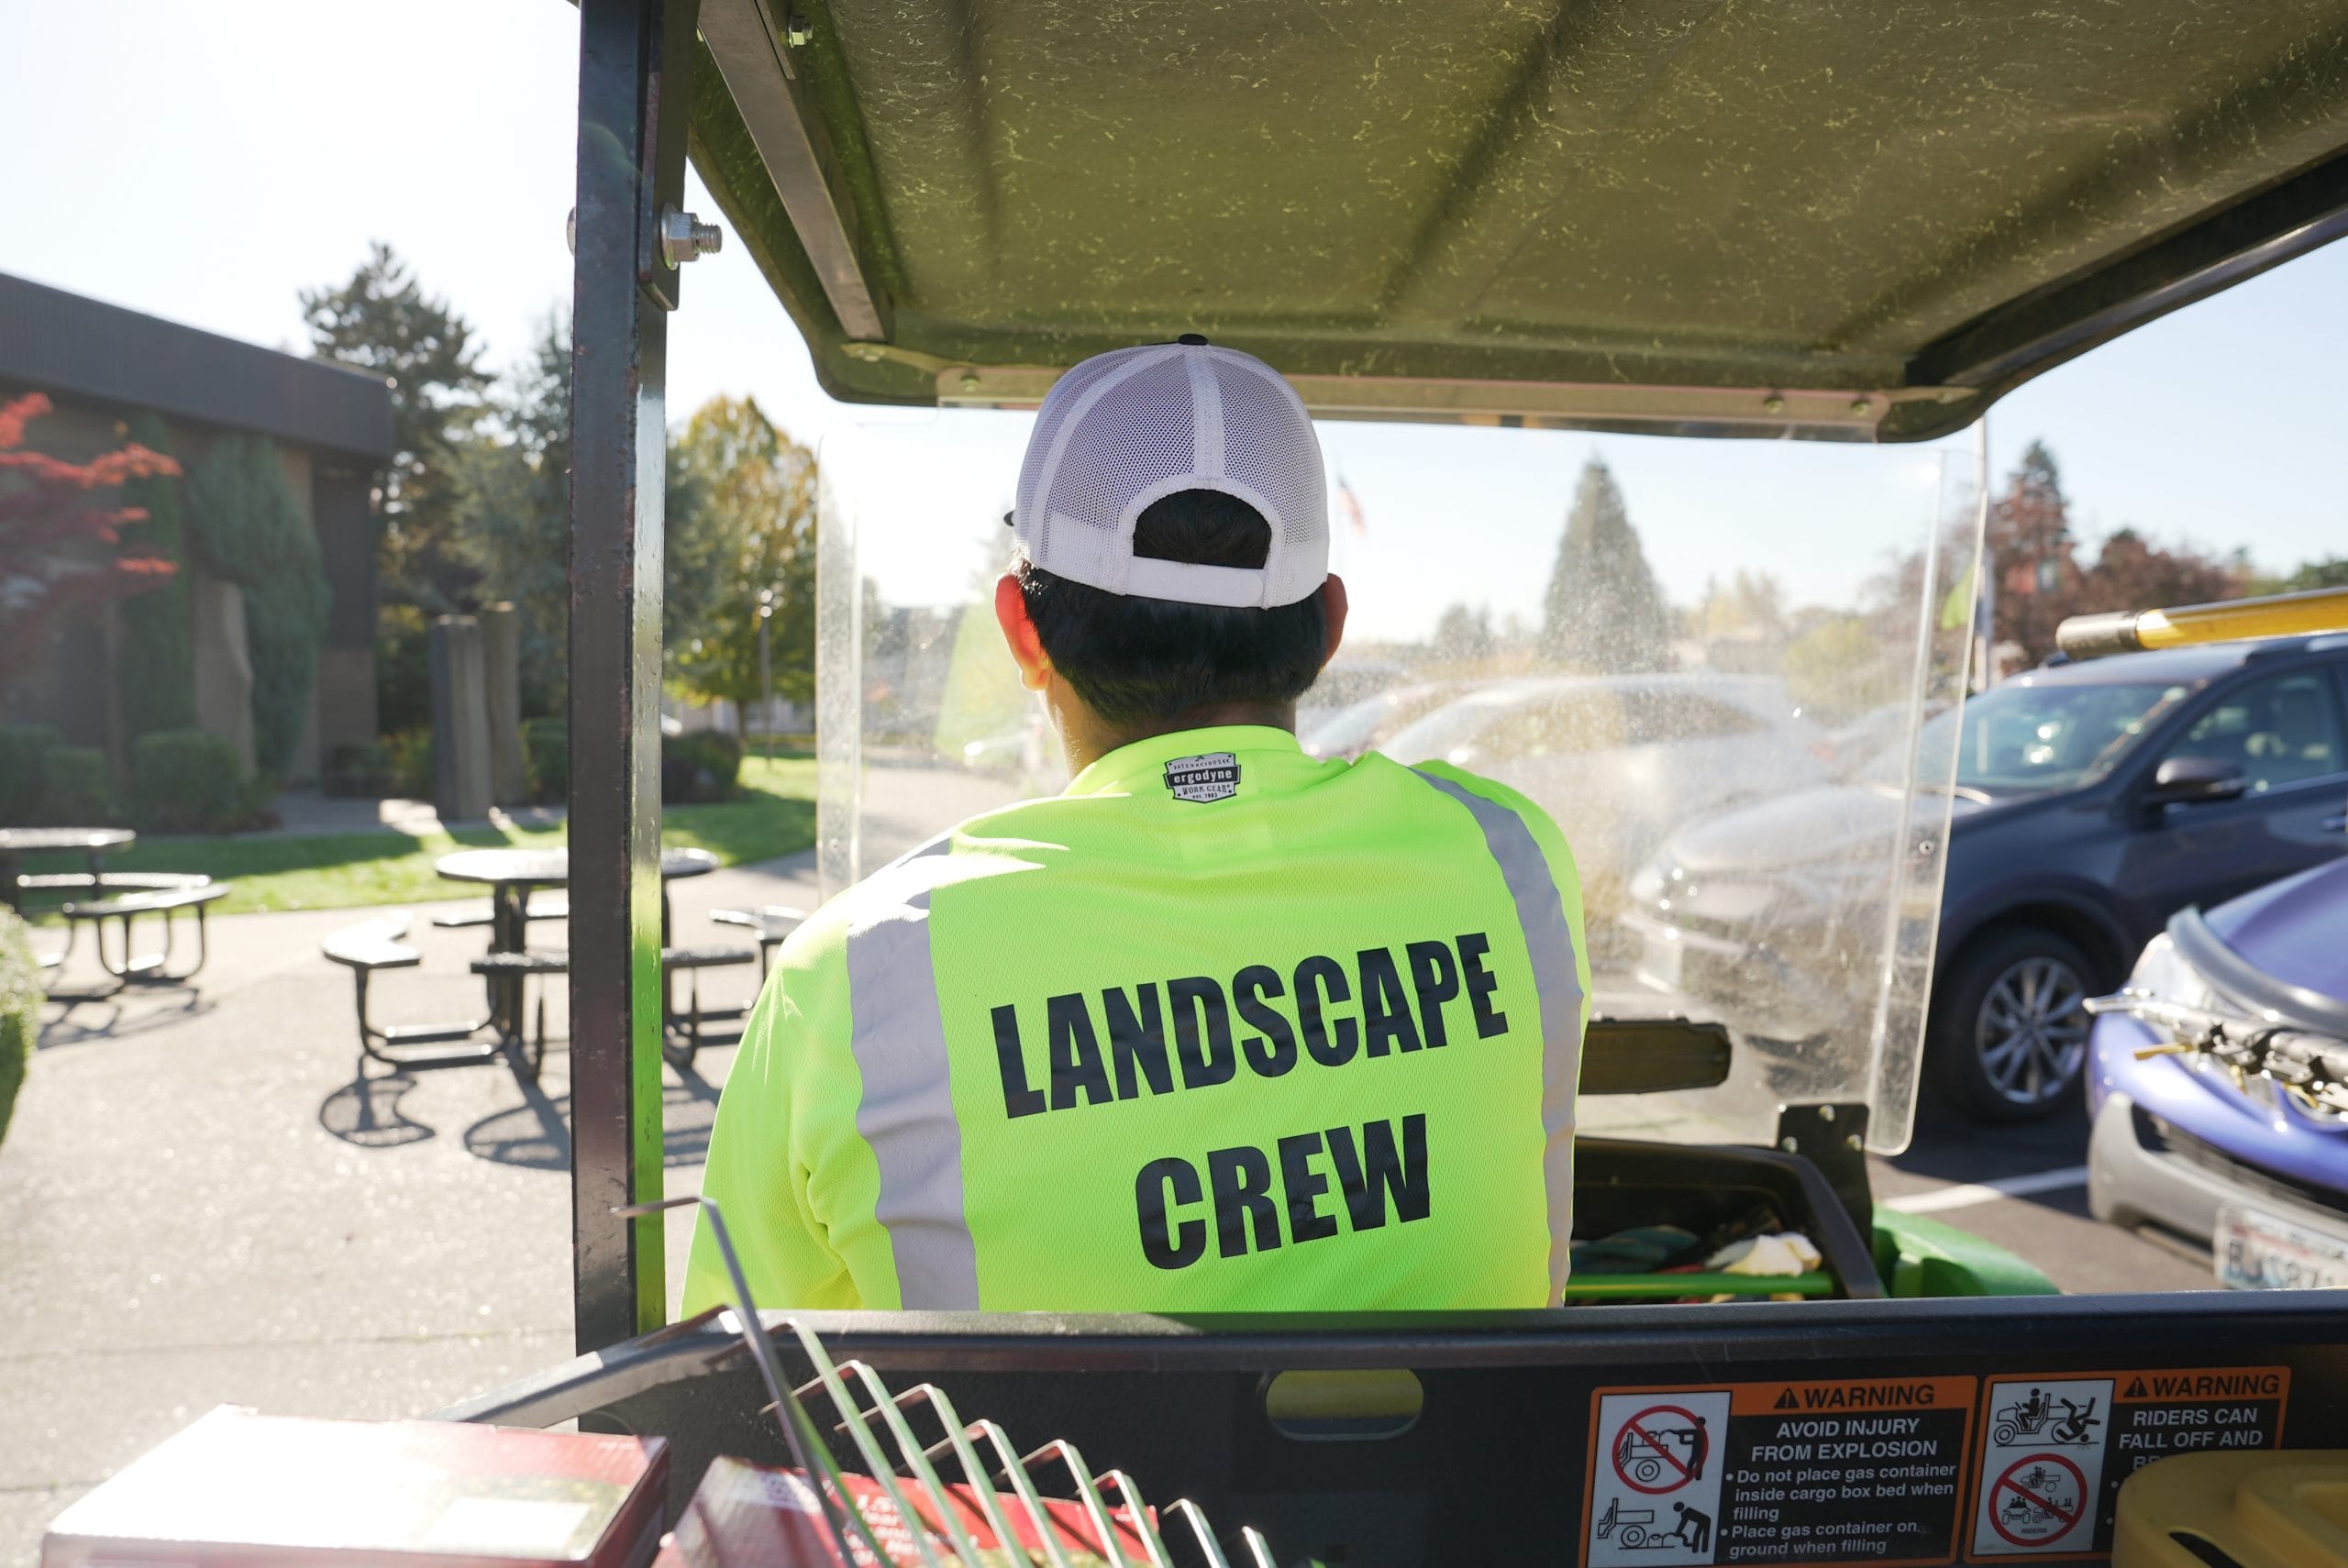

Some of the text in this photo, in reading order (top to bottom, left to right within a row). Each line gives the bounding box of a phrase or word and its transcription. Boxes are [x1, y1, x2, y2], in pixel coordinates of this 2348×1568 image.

[1173, 769, 1233, 784] ergodyne
[1181, 785, 1205, 795] WORK
[990, 932, 1509, 1119] LANDSCAPE
[1135, 1113, 1431, 1270] CREW
[2153, 1374, 2280, 1397] WARNING
[1803, 1385, 1935, 1408] WARNING
[2132, 1408, 2258, 1427] RIDERS CAN
[1776, 1418, 1921, 1439] AVOID INJURY
[2119, 1430, 2264, 1450] FALL OFF AND
[1751, 1441, 1937, 1463] FROM EXPLOSION
[1736, 1463, 1956, 1485] Do not place gas container
[1734, 1482, 1955, 1503] inside cargo box bed when
[1733, 1507, 1779, 1522] filling
[1731, 1525, 1778, 1539] Place
[1780, 1526, 1811, 1540] gas
[1815, 1520, 1892, 1536] container
[2021, 1527, 2047, 1535] RIDERS
[1729, 1538, 1888, 1560] ground when filling
